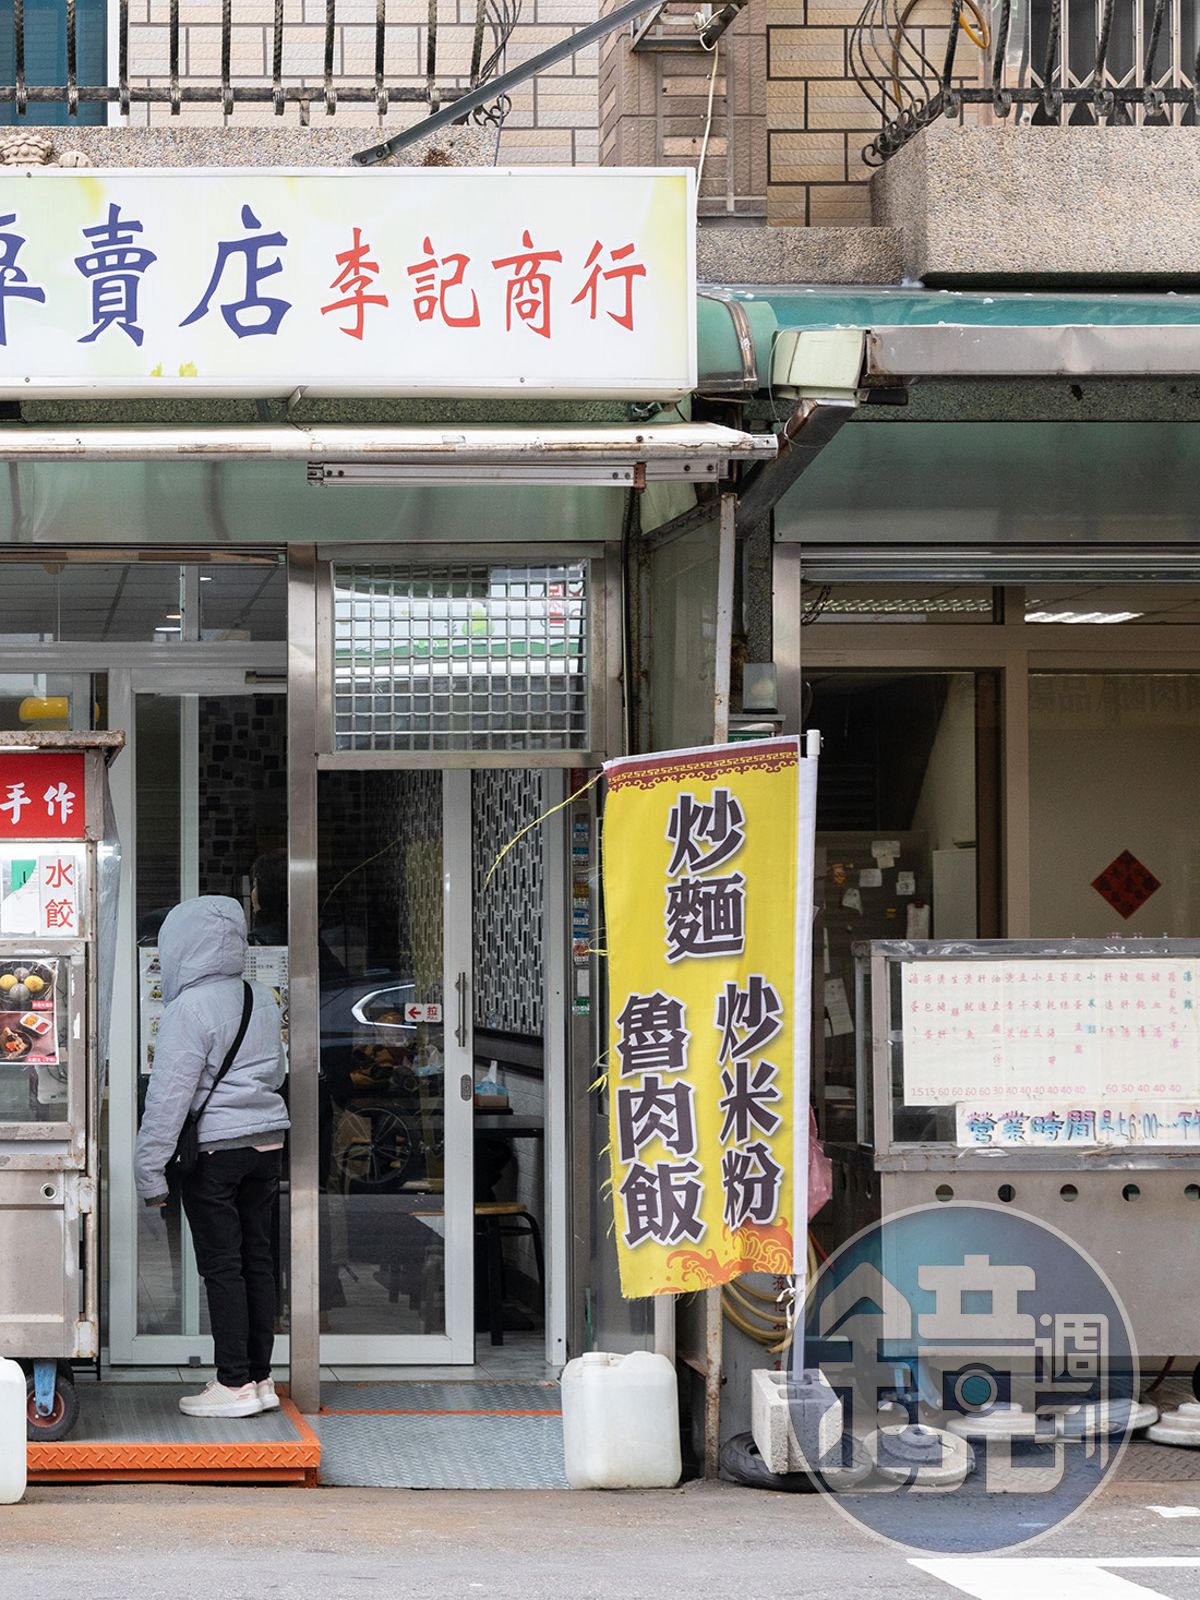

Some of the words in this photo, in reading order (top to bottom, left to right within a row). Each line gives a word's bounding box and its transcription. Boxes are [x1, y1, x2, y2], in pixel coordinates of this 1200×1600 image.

[321, 227, 647, 340] 李記商行
[45, 859, 74, 928] 水餃
[666, 788, 745, 964] 炒麵
[615, 991, 705, 1247] 魯肉飯
[715, 975, 784, 1228] 炒米粉
